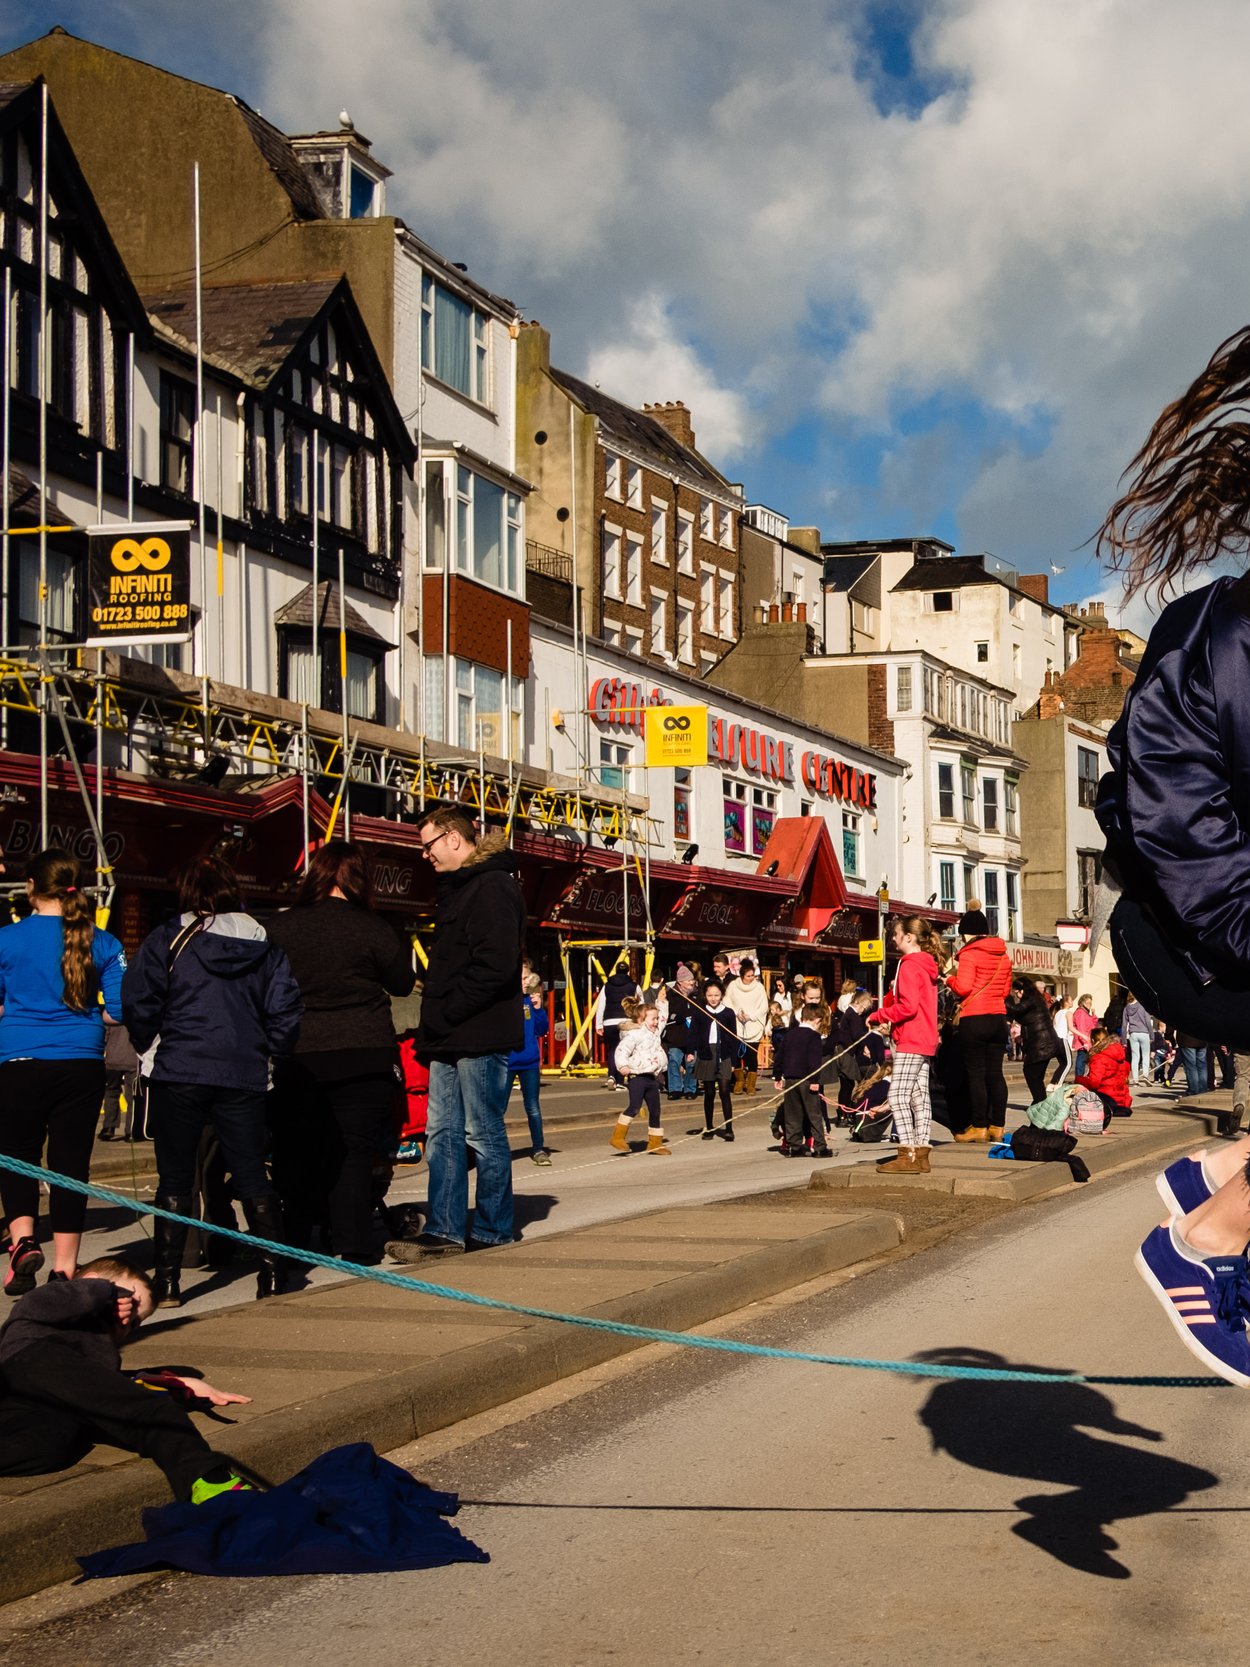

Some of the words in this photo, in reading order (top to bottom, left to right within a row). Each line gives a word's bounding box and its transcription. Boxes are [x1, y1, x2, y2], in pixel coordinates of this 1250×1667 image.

[110, 574, 172, 594] INFINITI
[110, 592, 172, 604] ROOFING
[92, 606, 132, 622] 01723
[135, 605, 160, 621] 500
[163, 603, 188, 619] 888
[589, 677, 674, 738] Gill'
[707, 713, 794, 782] EISURE
[802, 750, 878, 808] CENTRE
[5, 819, 125, 864] BINGO
[586, 888, 646, 918] FLOORS
[698, 902, 734, 925] POOL
[1012, 948, 1034, 968] JOHN
[1035, 950, 1055, 970] BULL
